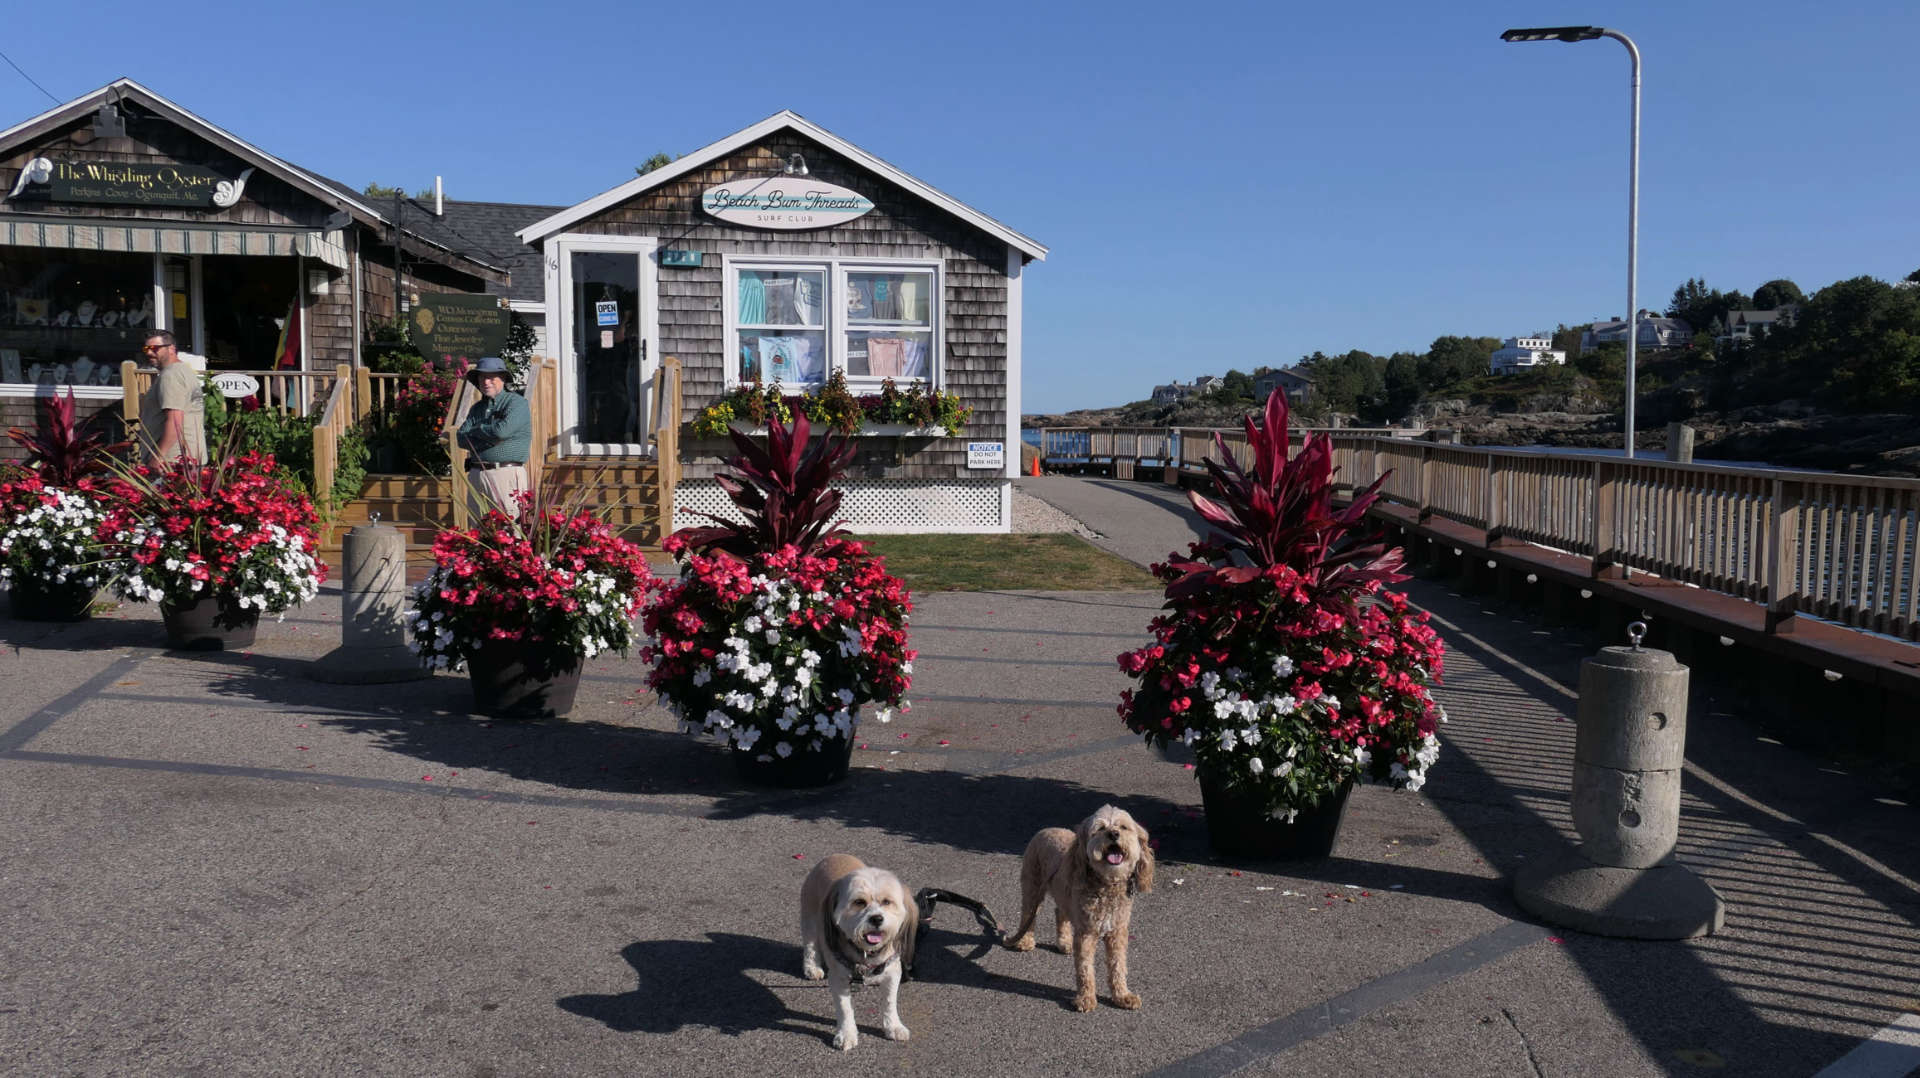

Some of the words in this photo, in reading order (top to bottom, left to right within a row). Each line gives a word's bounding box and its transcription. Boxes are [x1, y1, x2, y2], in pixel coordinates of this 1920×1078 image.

[56, 163, 84, 180] The
[87, 165, 152, 189] Whistling
[157, 168, 216, 191] Oyster
[105, 188, 129, 198] Cove
[708, 189, 759, 209] Beach
[761, 190, 801, 210] Bum
[805, 190, 859, 210] Threads
[598, 304, 617, 313] OPEN
[215, 380, 251, 390] OPEN
